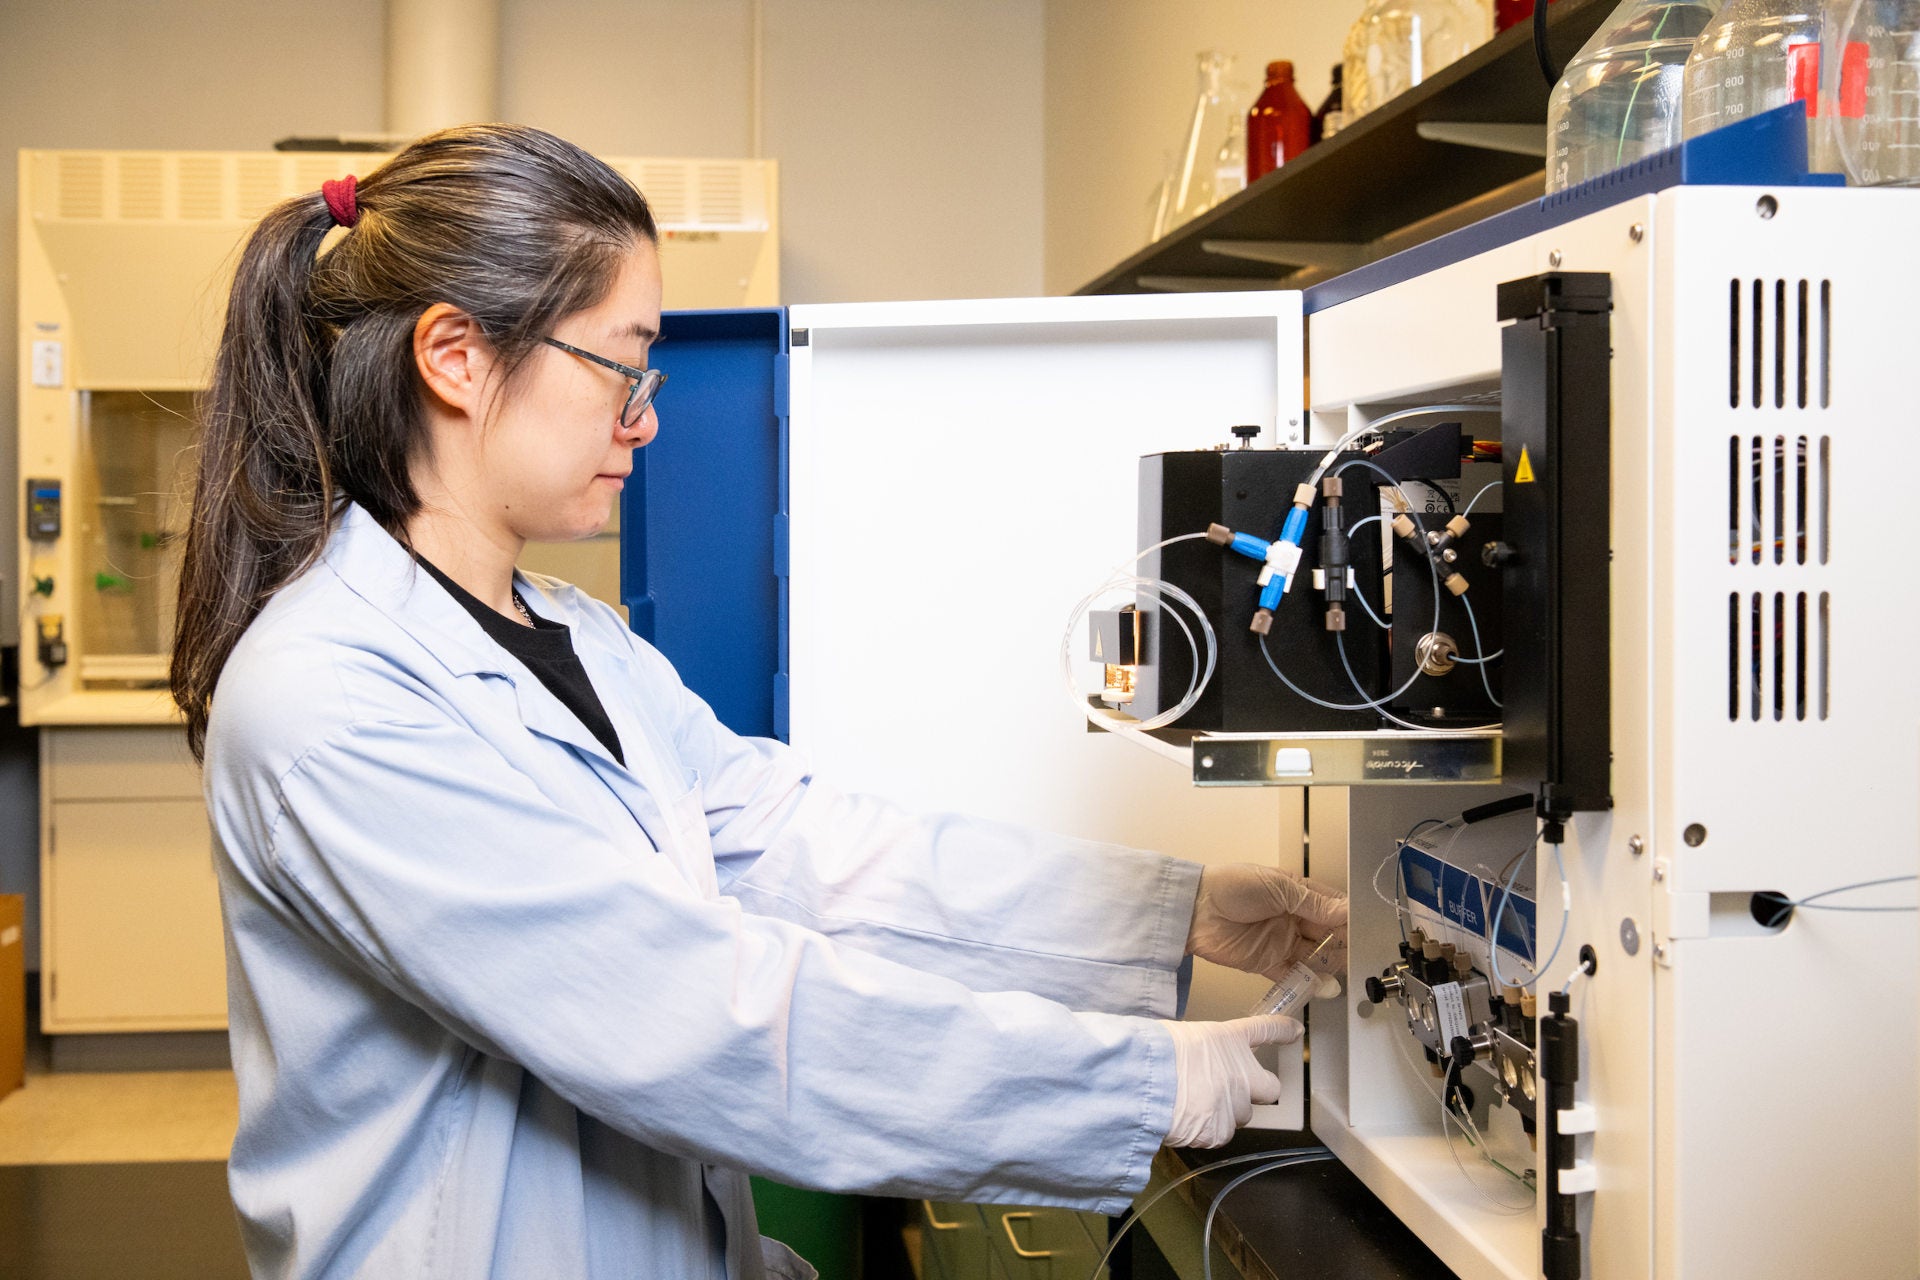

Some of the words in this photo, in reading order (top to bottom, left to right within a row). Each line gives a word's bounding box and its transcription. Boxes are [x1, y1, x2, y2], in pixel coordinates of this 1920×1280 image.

[1725, 47, 1744, 60] 900
[1725, 75, 1744, 88] 800
[1725, 103, 1743, 116] 700
[1448, 901, 1478, 925] BUFFER
